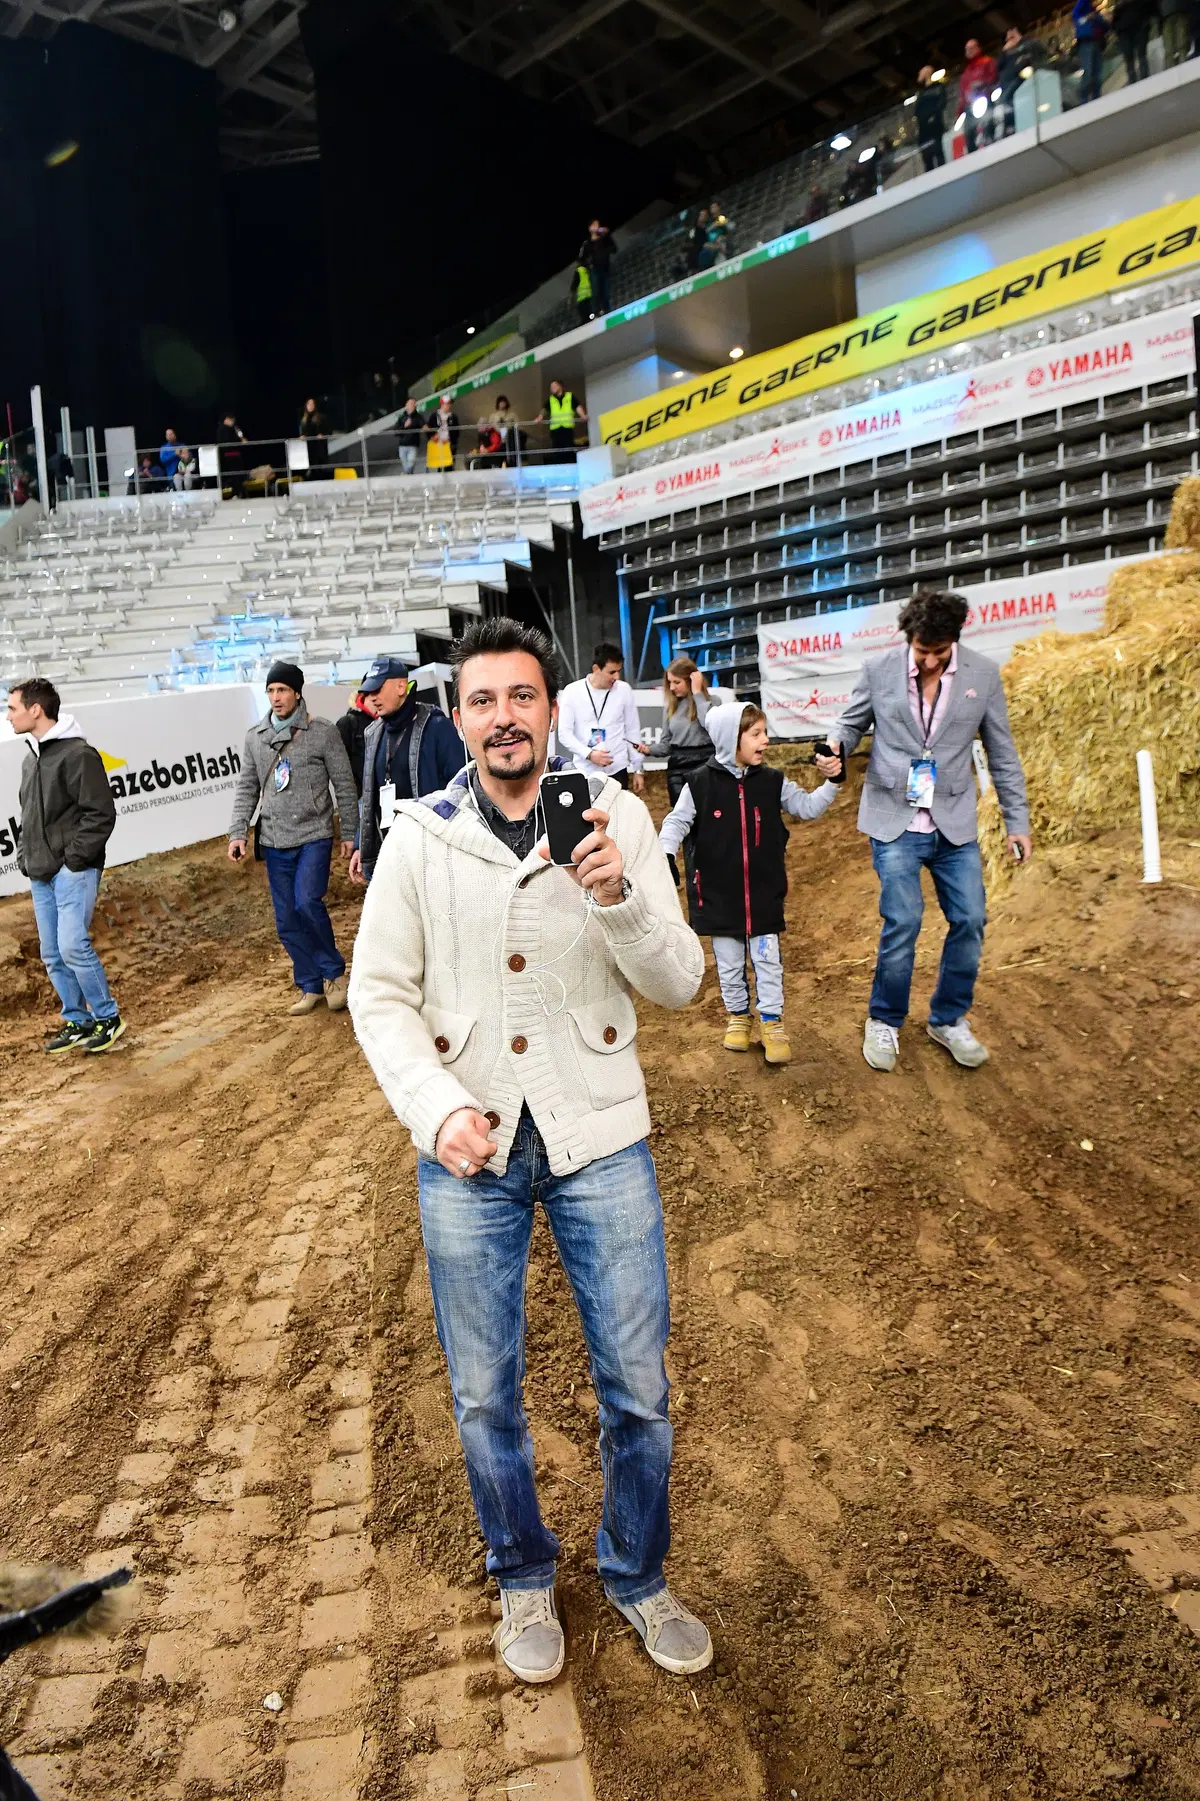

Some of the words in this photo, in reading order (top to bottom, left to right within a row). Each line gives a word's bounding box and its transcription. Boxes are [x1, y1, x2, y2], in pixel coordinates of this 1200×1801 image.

[738, 314, 898, 405] GAERNE
[907, 238, 1106, 347] GAERNE
[669, 461, 721, 491] YAMAHA
[836, 409, 901, 441] YAMAHA
[1048, 341, 1133, 381] YAMAHA
[979, 592, 1056, 624] YAMAHA
[780, 632, 842, 656] YAMAHA
[109, 747, 241, 799] azeboFlash
[121, 801, 149, 815] GAZEBO
[149, 789, 202, 807] PERSONALIZZATO
[202, 785, 214, 795] CHE
[220, 781, 235, 790] APRE
